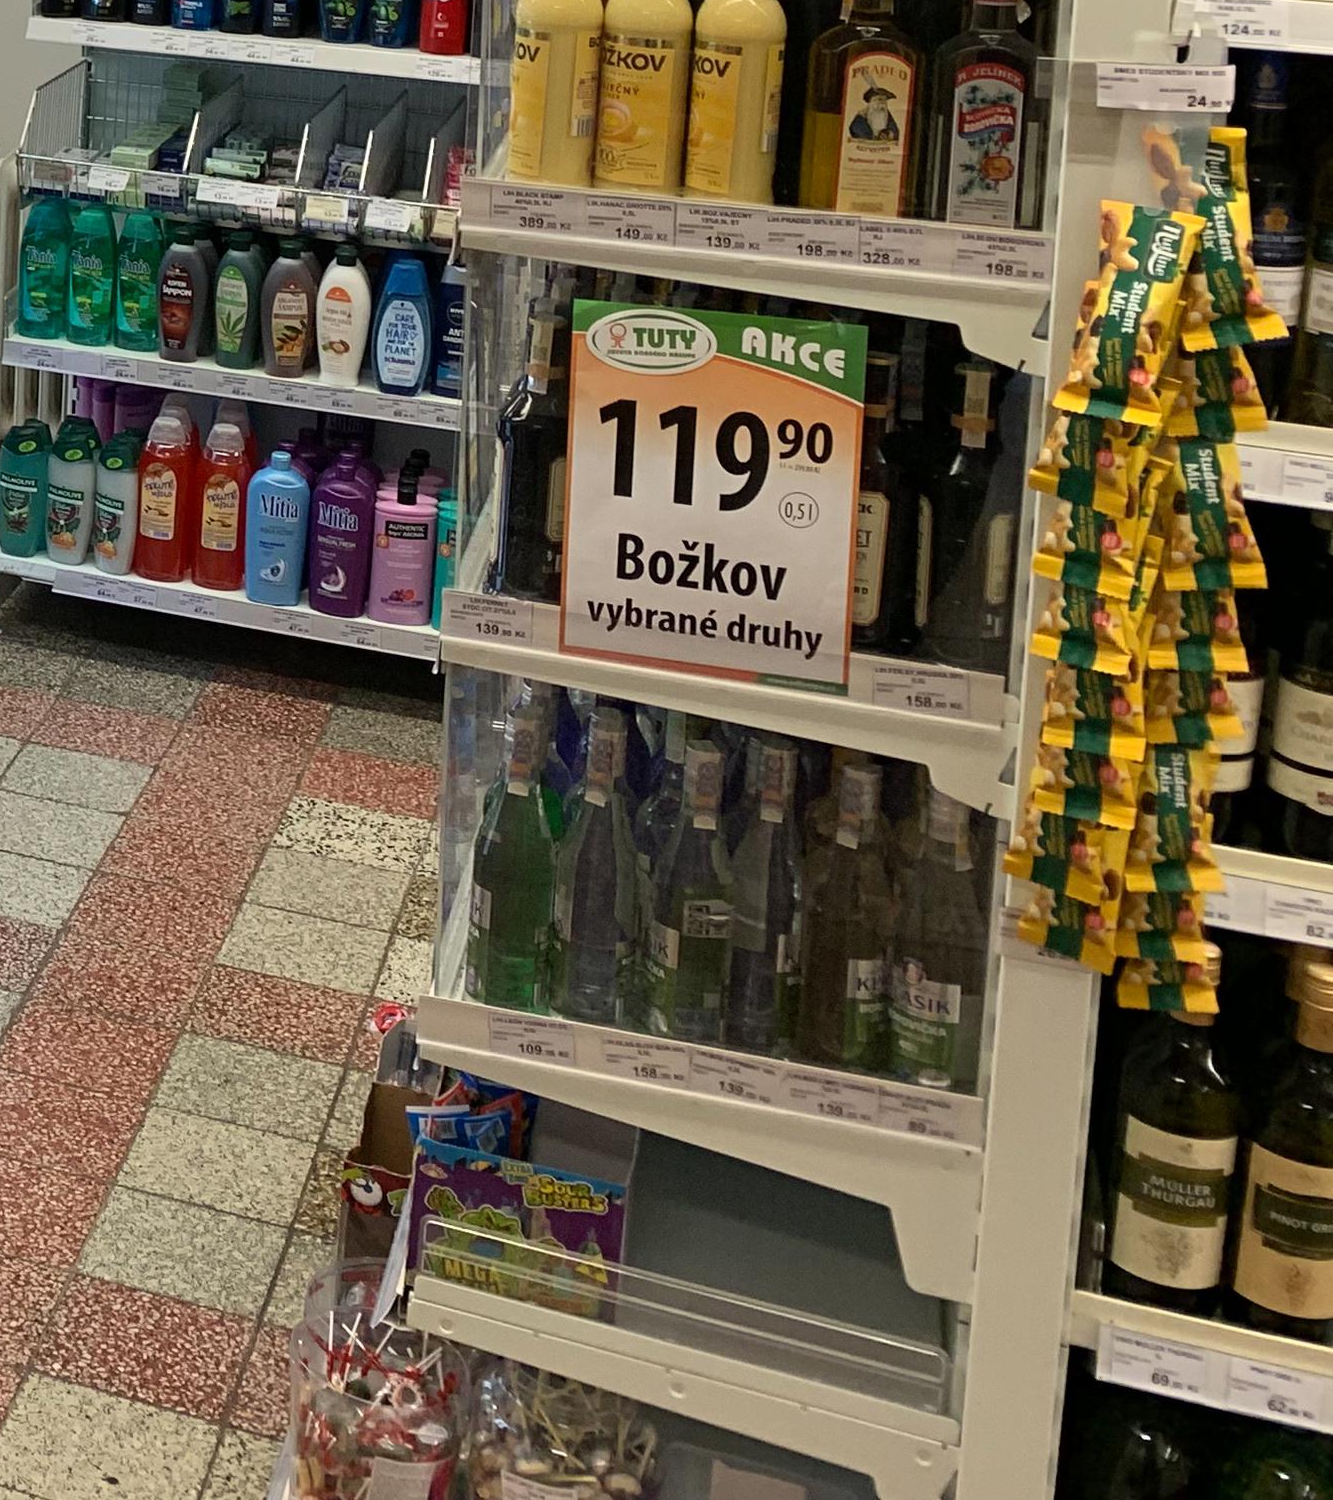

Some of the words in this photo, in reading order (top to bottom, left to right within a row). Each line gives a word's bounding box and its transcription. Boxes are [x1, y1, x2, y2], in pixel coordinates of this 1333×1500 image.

[1213, 205, 1236, 263] Student
[26, 246, 57, 263] Tania
[72, 250, 103, 269] Tania
[121, 255, 150, 274] Tania
[395, 313, 415, 323] CARE
[1108, 290, 1123, 322] Mix
[1120, 280, 1149, 335] Student
[386, 329, 410, 340] HAIR
[633, 326, 697, 350] TUTY
[385, 345, 417, 357] PLANET
[741, 326, 845, 380] AKCE
[599, 398, 771, 513] 119
[777, 418, 834, 464] 90
[1, 474, 36, 486] PALMOLIVE
[1184, 463, 1200, 492] Mix
[1198, 448, 1222, 505] Student
[50, 487, 83, 499] PALMOLIVE
[259, 494, 300, 523] Mitia
[318, 502, 359, 532] Mitia
[389, 523, 425, 532] AUTHENTIC
[616, 532, 788, 602] Božkov
[587, 598, 718, 640] vybrané
[727, 613, 823, 660] druhy
[1158, 765, 1171, 798] Mix
[1170, 752, 1188, 810] Student
[526, 1189, 606, 1212] BUSTERS
[539, 1175, 592, 1199] SOUR
[1142, 1182, 1216, 1209] THURGAU
[1270, 1211, 1307, 1231] PINOT
